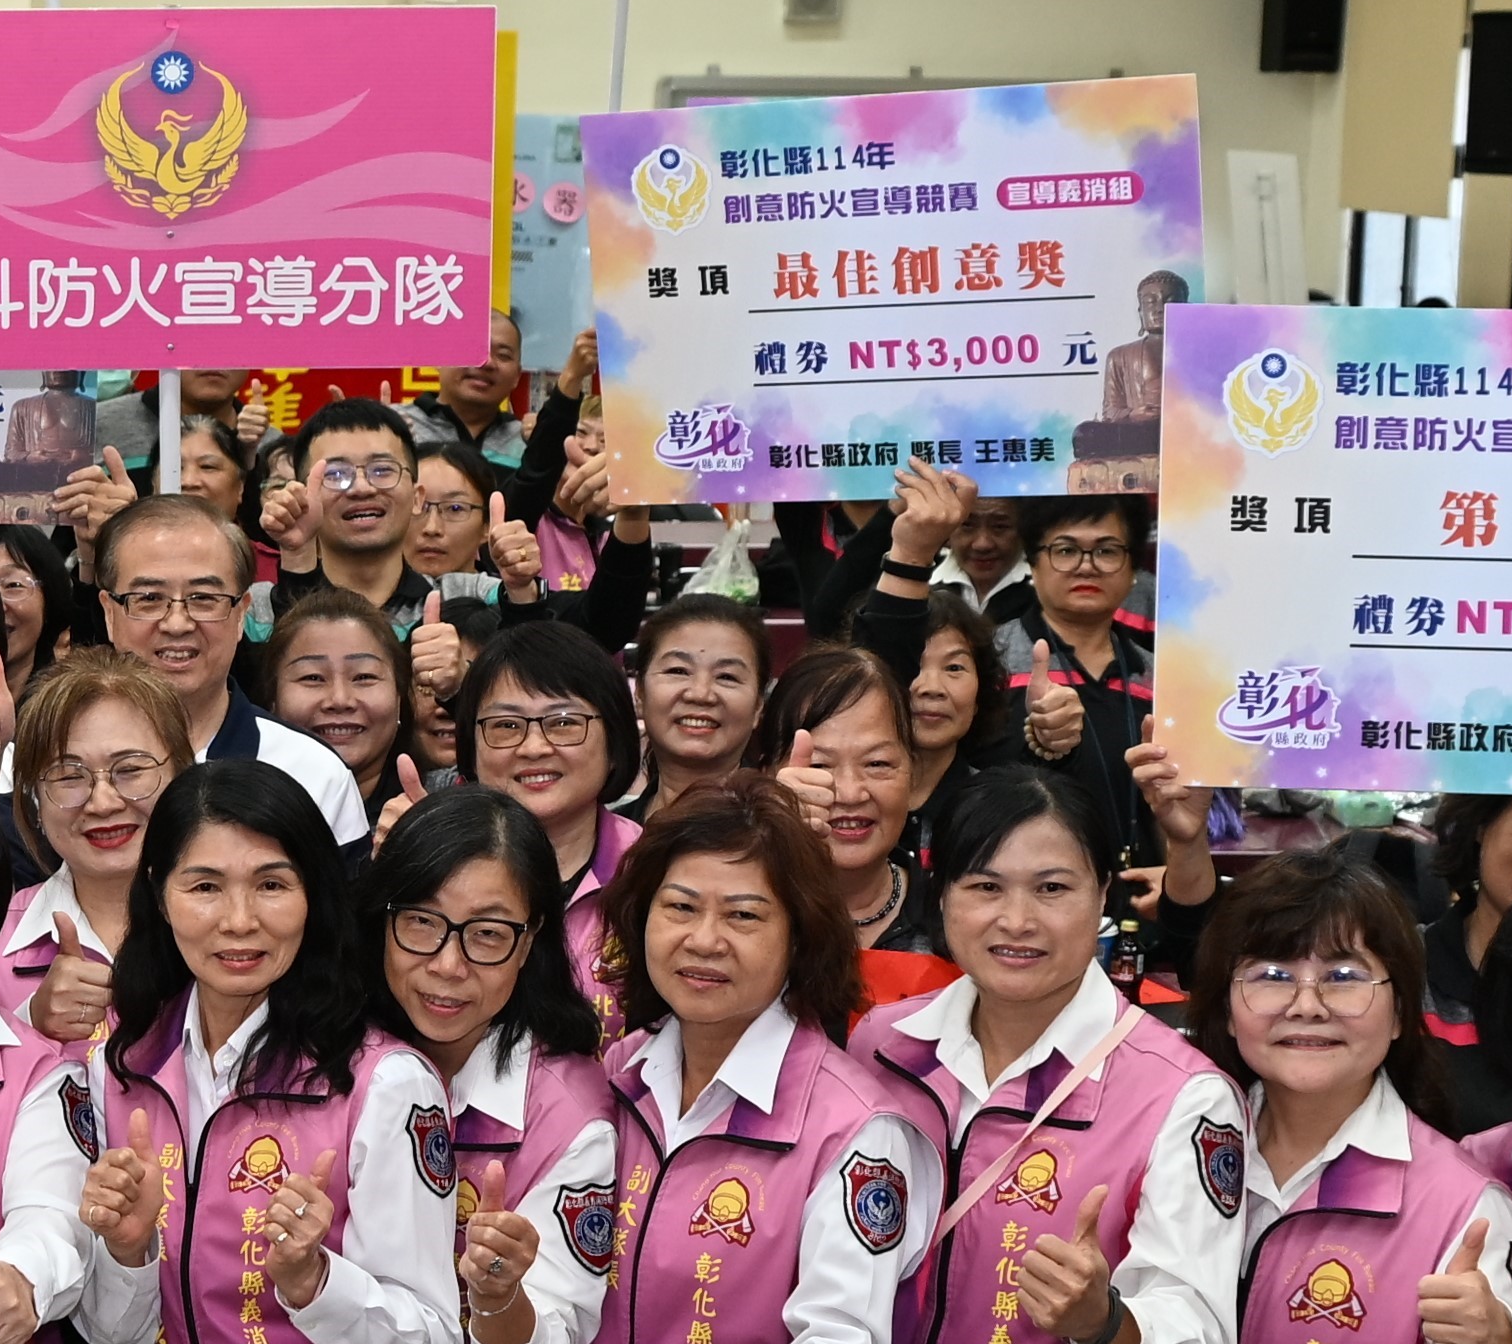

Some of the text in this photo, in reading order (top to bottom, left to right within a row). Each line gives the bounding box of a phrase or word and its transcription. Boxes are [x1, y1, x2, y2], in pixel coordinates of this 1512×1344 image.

[720, 142, 895, 179] 彰化縣114年
[724, 182, 978, 224] 創意防火宣導競賽
[1007, 180, 1135, 207] 宣導義消組
[774, 241, 1066, 300] 最佳創意獎
[849, 333, 1040, 370] NT$3,000
[1064, 334, 1098, 367] 元
[769, 437, 1055, 468] 彰化縣政府 縣長 王惠美
